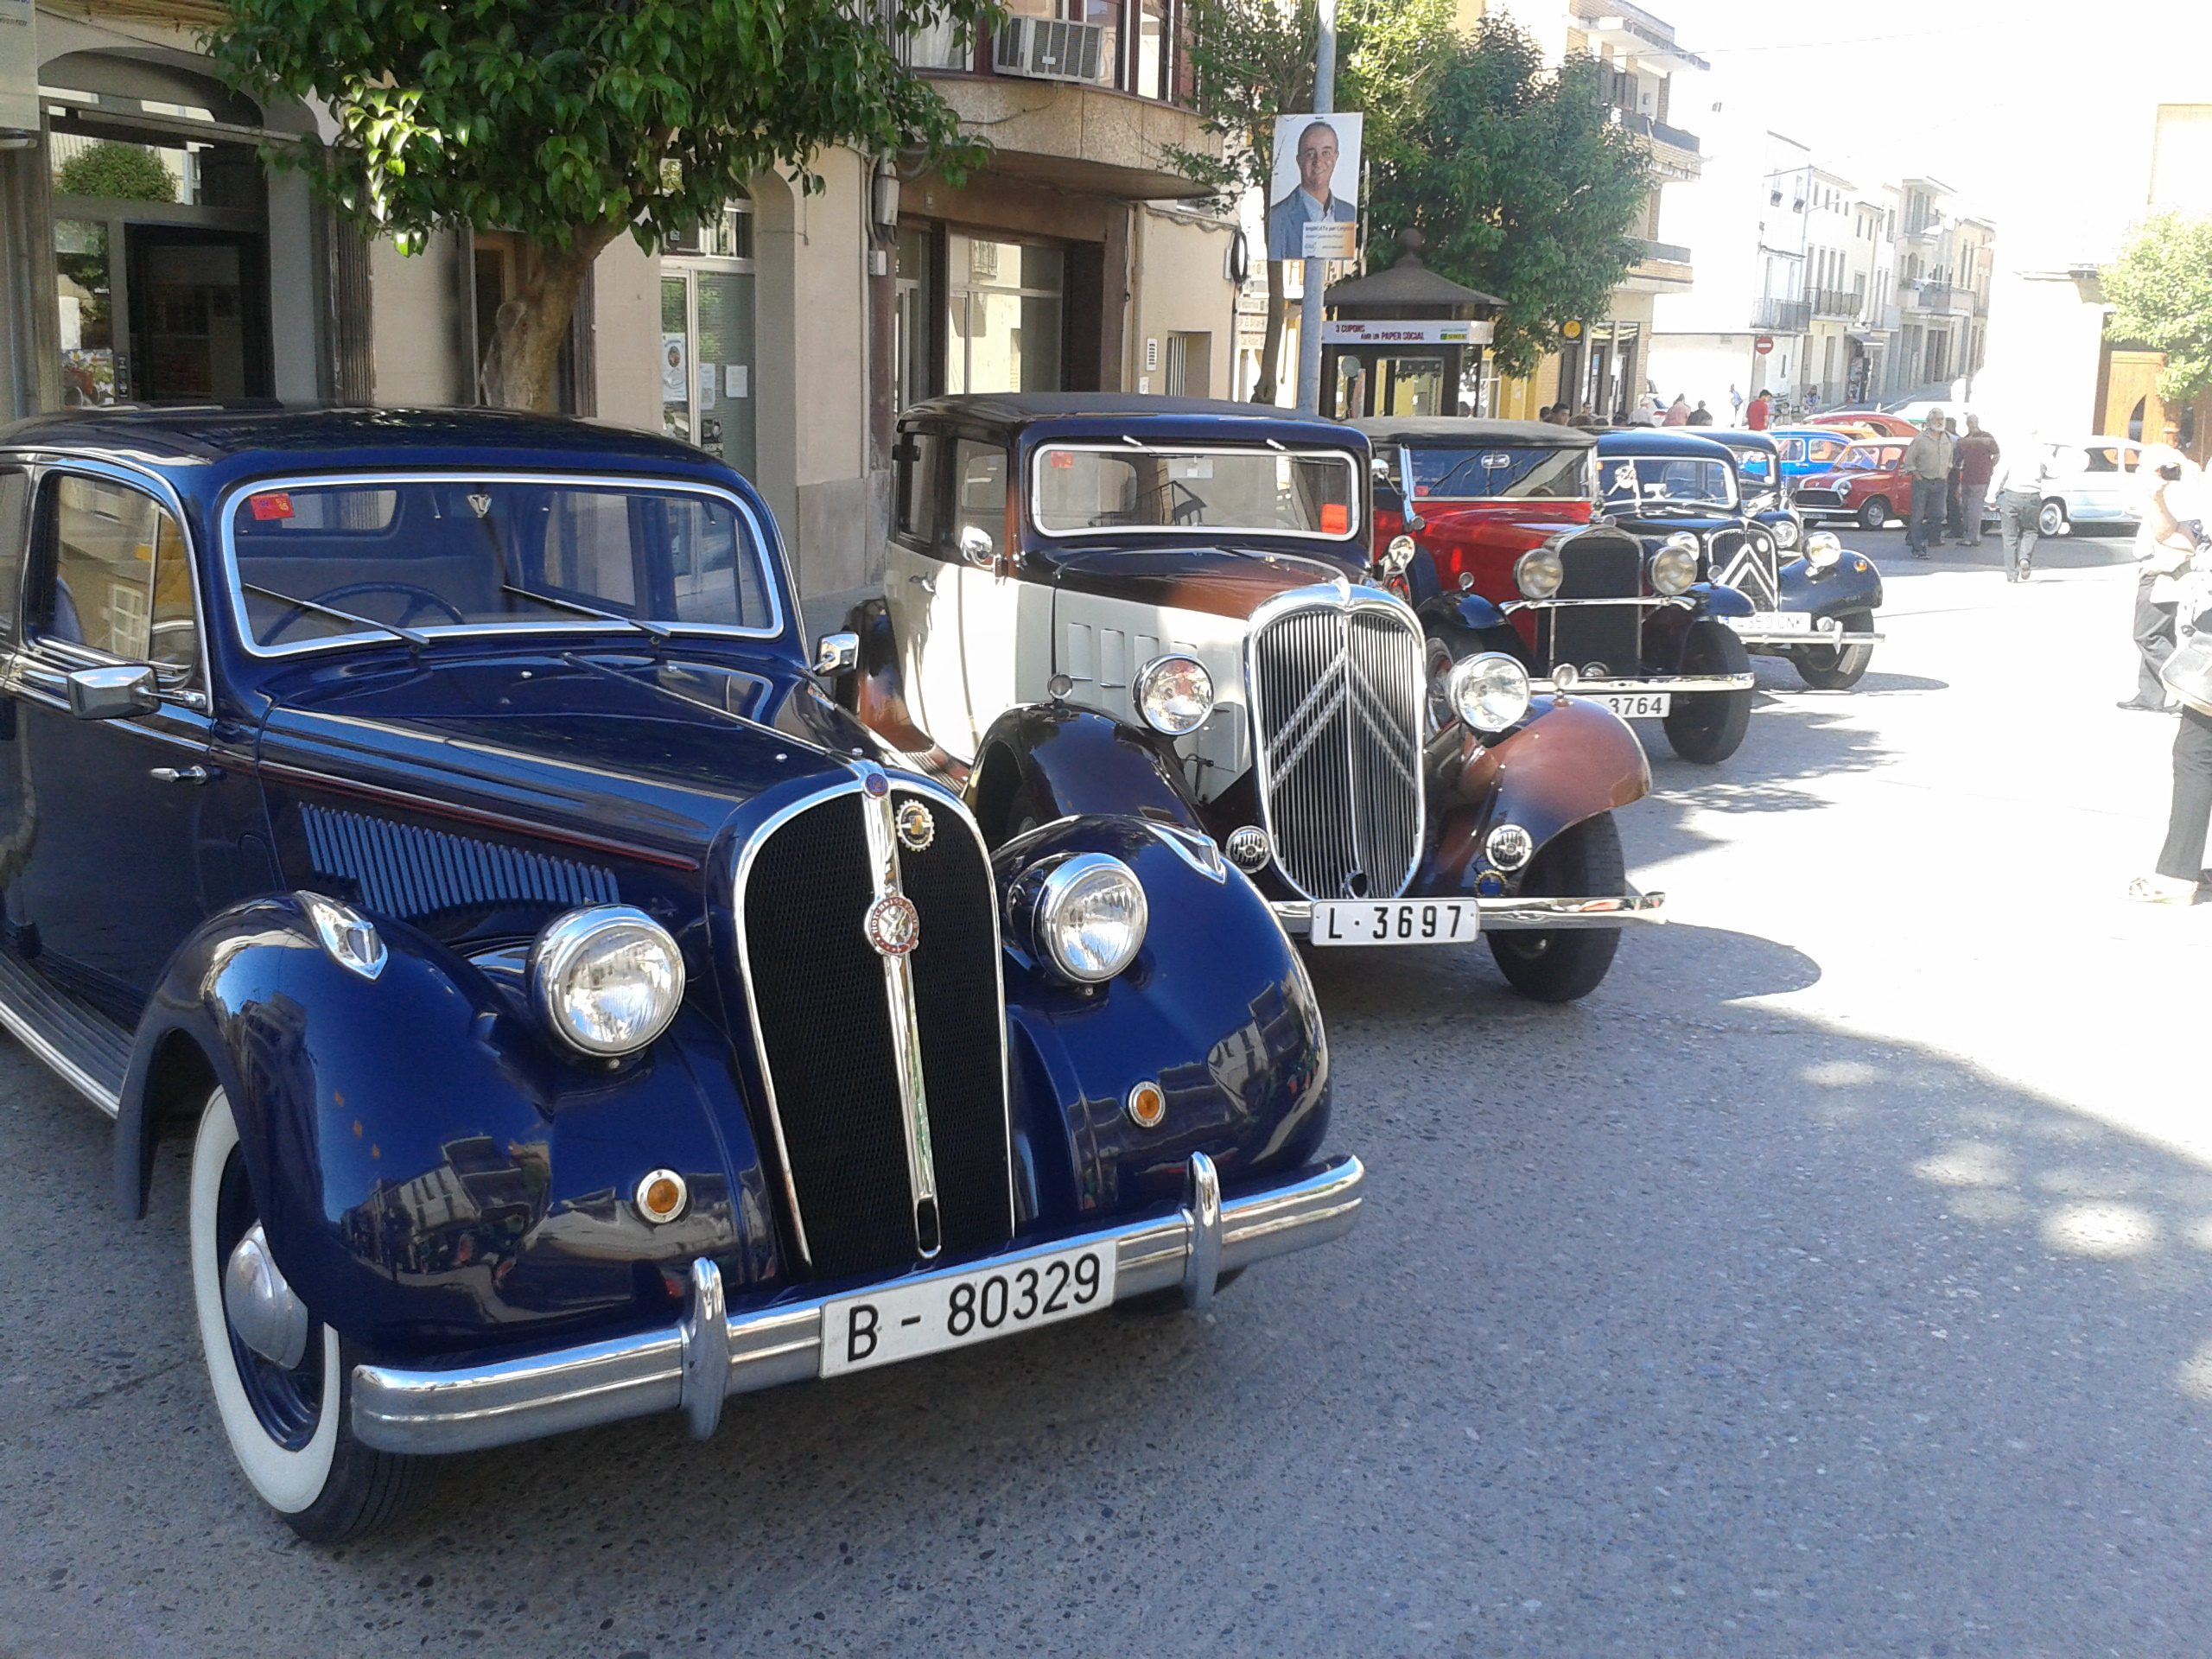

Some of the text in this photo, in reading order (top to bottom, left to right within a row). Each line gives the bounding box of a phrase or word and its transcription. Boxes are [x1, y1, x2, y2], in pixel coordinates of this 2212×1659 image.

[1382, 332, 1402, 340] PAPER
[1402, 332, 1425, 340] SOCIAL
[1608, 696, 1663, 716] 3764
